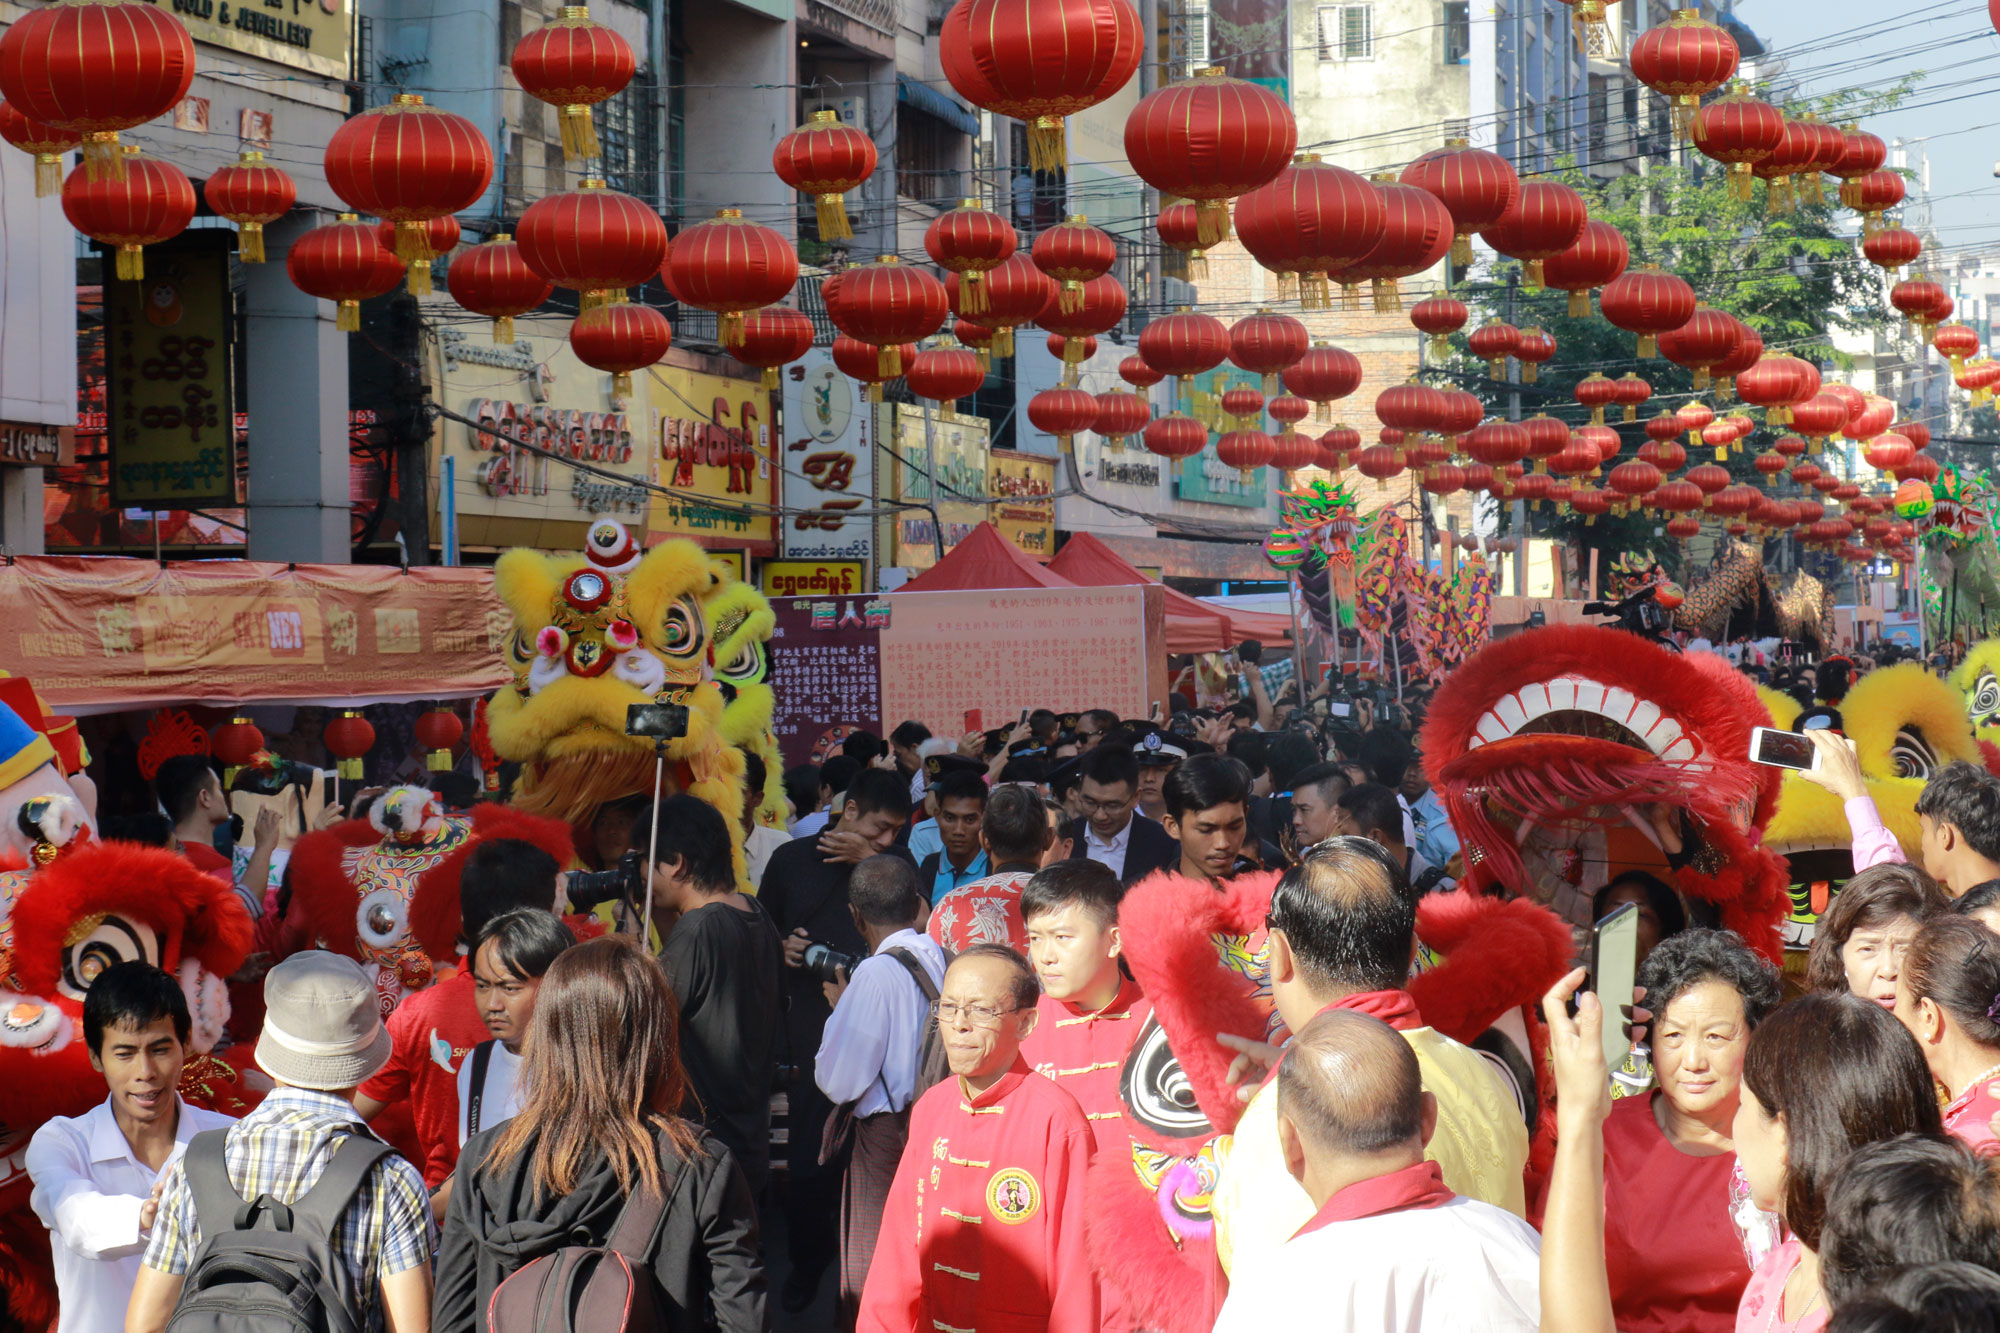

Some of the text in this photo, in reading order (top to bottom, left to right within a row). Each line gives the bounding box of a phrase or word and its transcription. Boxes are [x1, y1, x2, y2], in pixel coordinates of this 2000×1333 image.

[218, 1, 231, 25] &
[235, 7, 313, 49] JEWELLERY
[267, 611, 303, 649] NET
[811, 600, 891, 630] 唐人街
[470, 1095, 480, 1136] Canon
